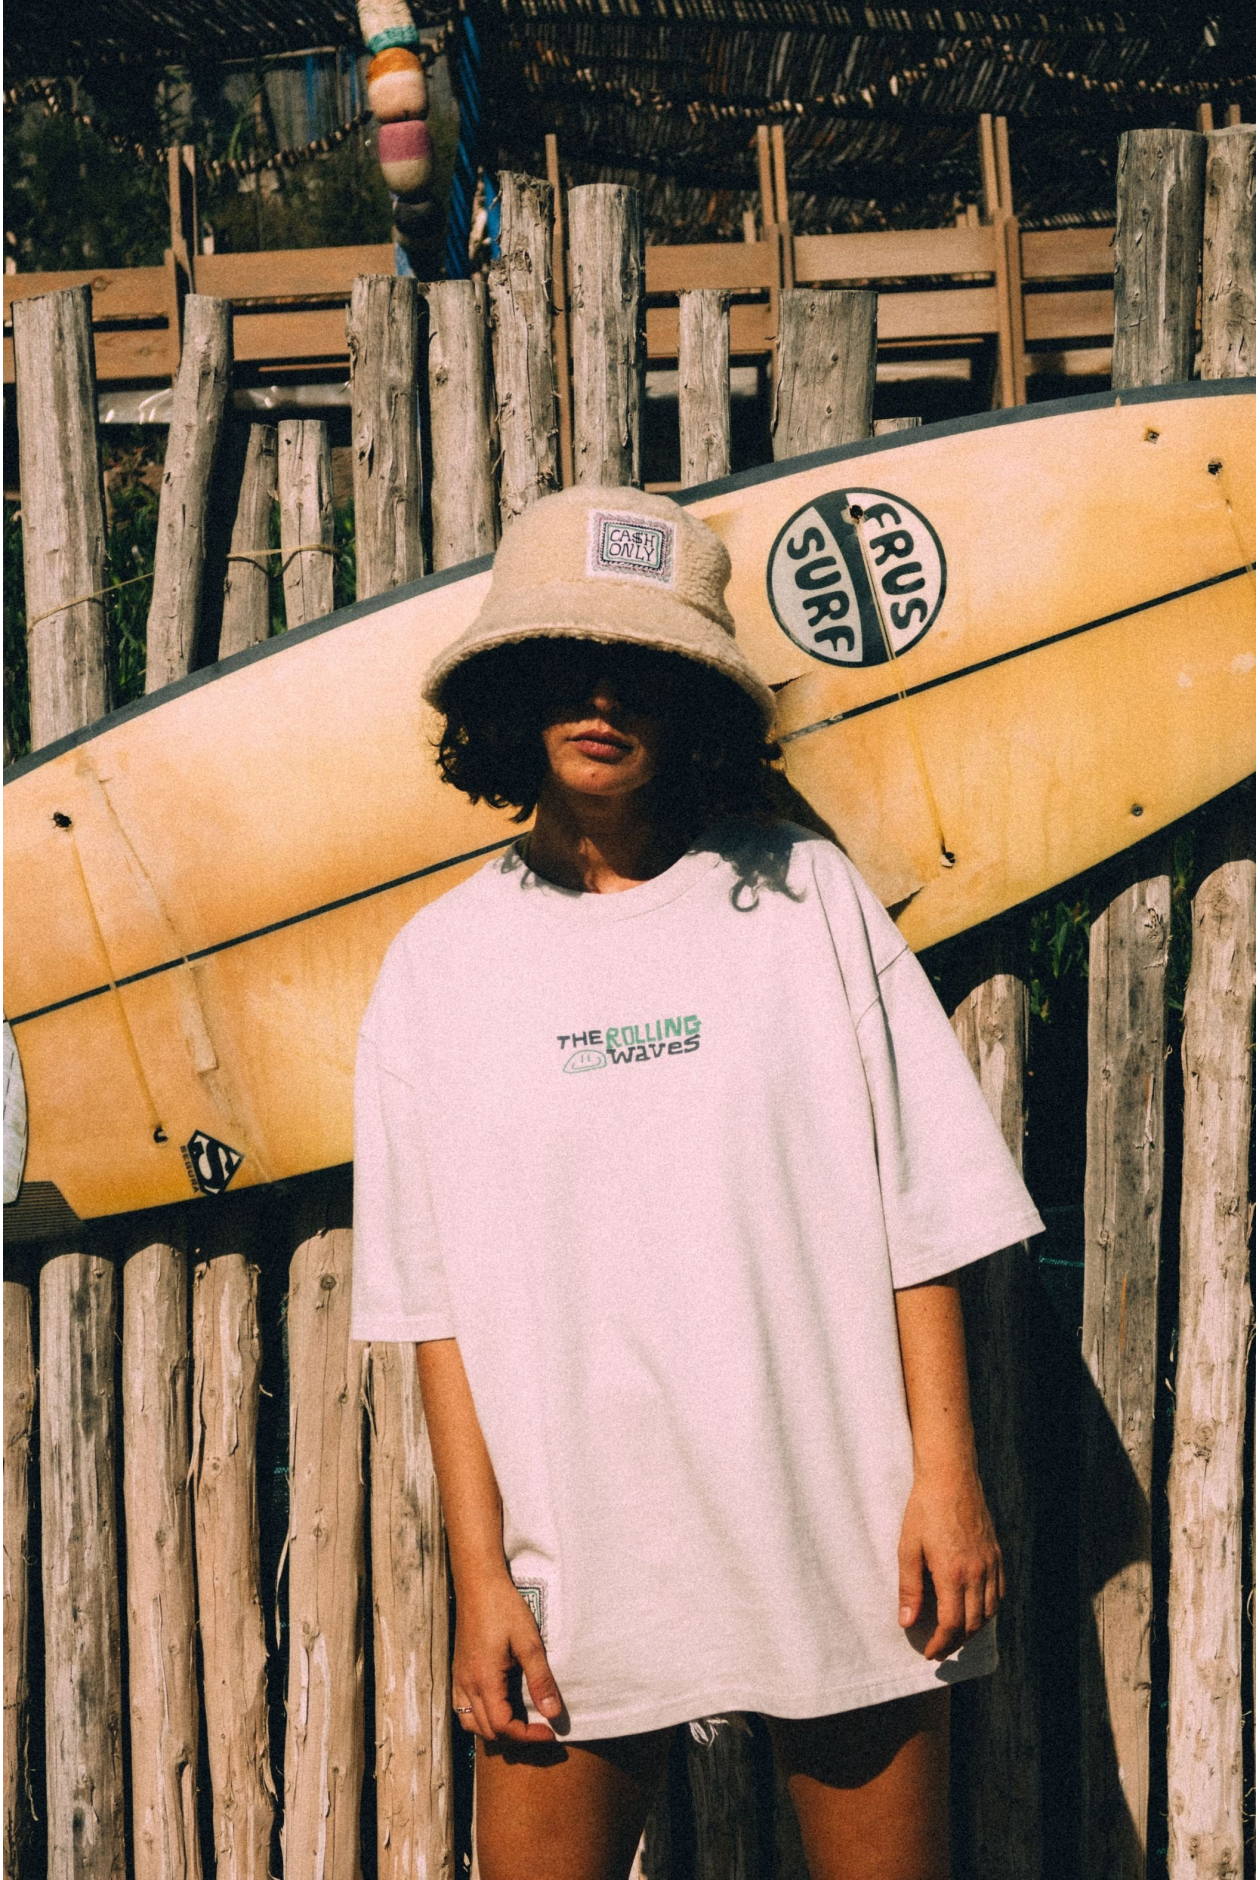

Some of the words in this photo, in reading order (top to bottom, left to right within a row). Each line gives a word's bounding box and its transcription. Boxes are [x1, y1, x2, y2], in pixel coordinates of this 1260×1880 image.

[609, 542, 655, 562] ONLY
[610, 529, 656, 547] CA$H
[863, 502, 928, 630] FRUS
[786, 526, 855, 652] SURF
[556, 1029, 604, 1050] THE
[605, 1014, 702, 1050] ROLLING
